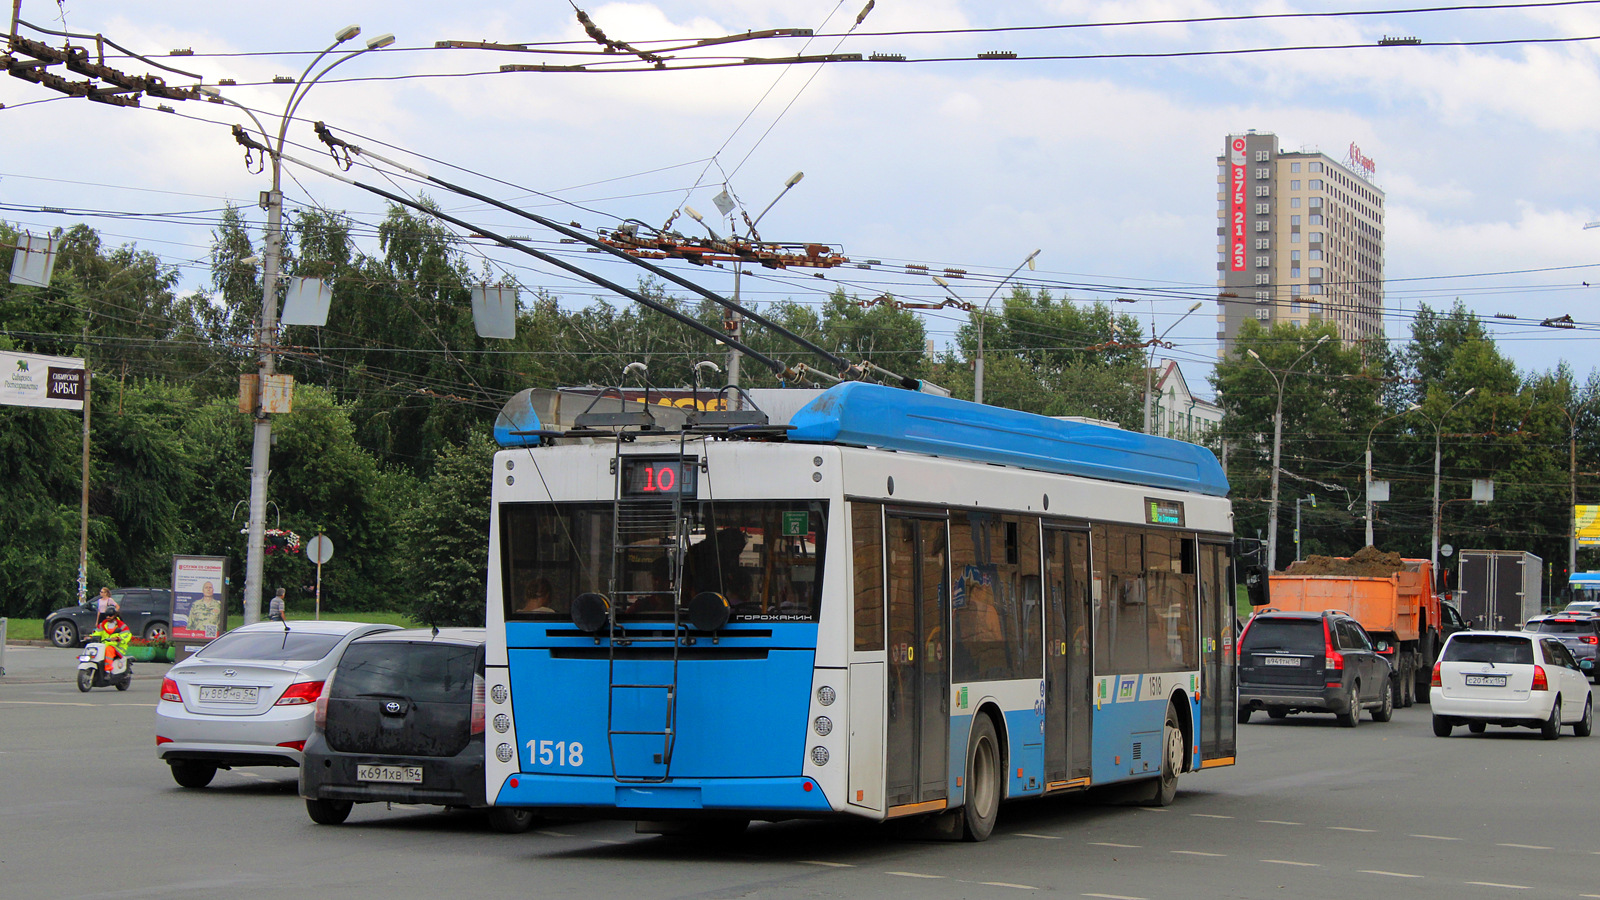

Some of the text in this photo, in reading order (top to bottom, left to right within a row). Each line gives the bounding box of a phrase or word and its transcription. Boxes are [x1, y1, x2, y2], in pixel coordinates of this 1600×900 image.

[52, 373, 79, 381] СИБИРСКИЙ
[52, 382, 79, 395] АРБАТ
[643, 467, 675, 491] 10
[1149, 676, 1162, 696] 1518
[526, 739, 584, 767] 1518
[404, 768, 421, 778] 154
